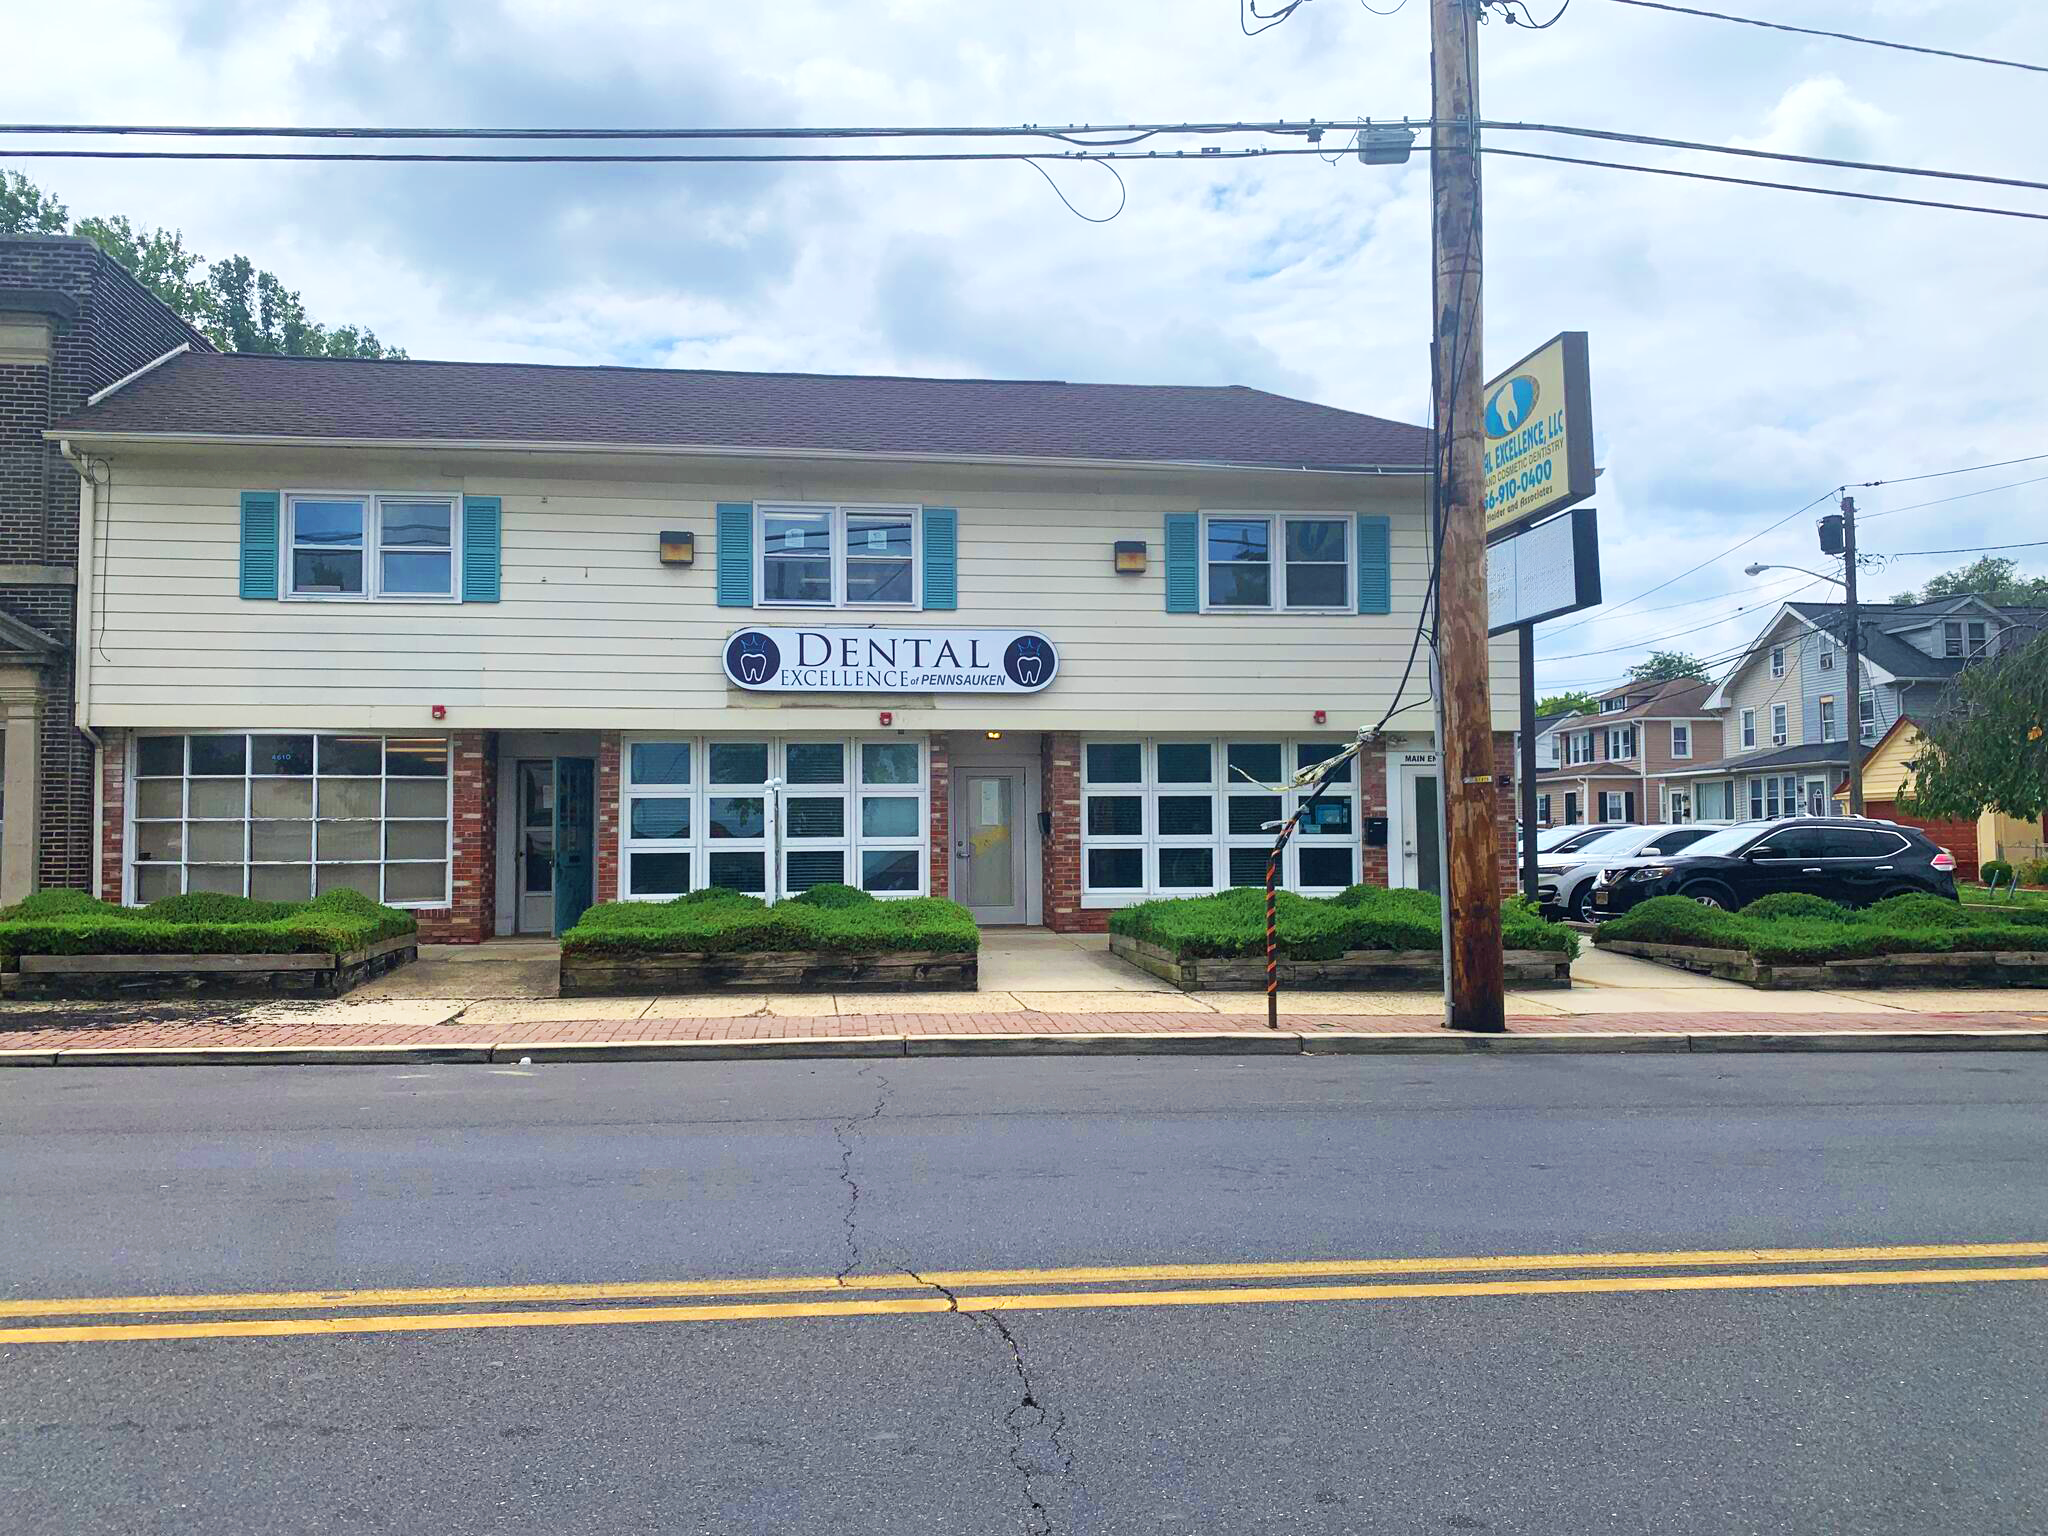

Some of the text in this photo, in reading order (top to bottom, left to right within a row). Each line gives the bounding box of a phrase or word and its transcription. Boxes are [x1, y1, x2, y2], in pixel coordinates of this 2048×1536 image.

[1484, 410, 1563, 475] AL EXCELLENCE, LLC
[1498, 457, 1528, 481] COSMETIC
[1529, 438, 1564, 464] DENTISTRY
[1507, 500, 1519, 513] and
[1520, 485, 1553, 508] Associates
[795, 632, 990, 669] DENTAL
[781, 669, 1006, 687] EXCELLENCE of PENNSAUKEN
